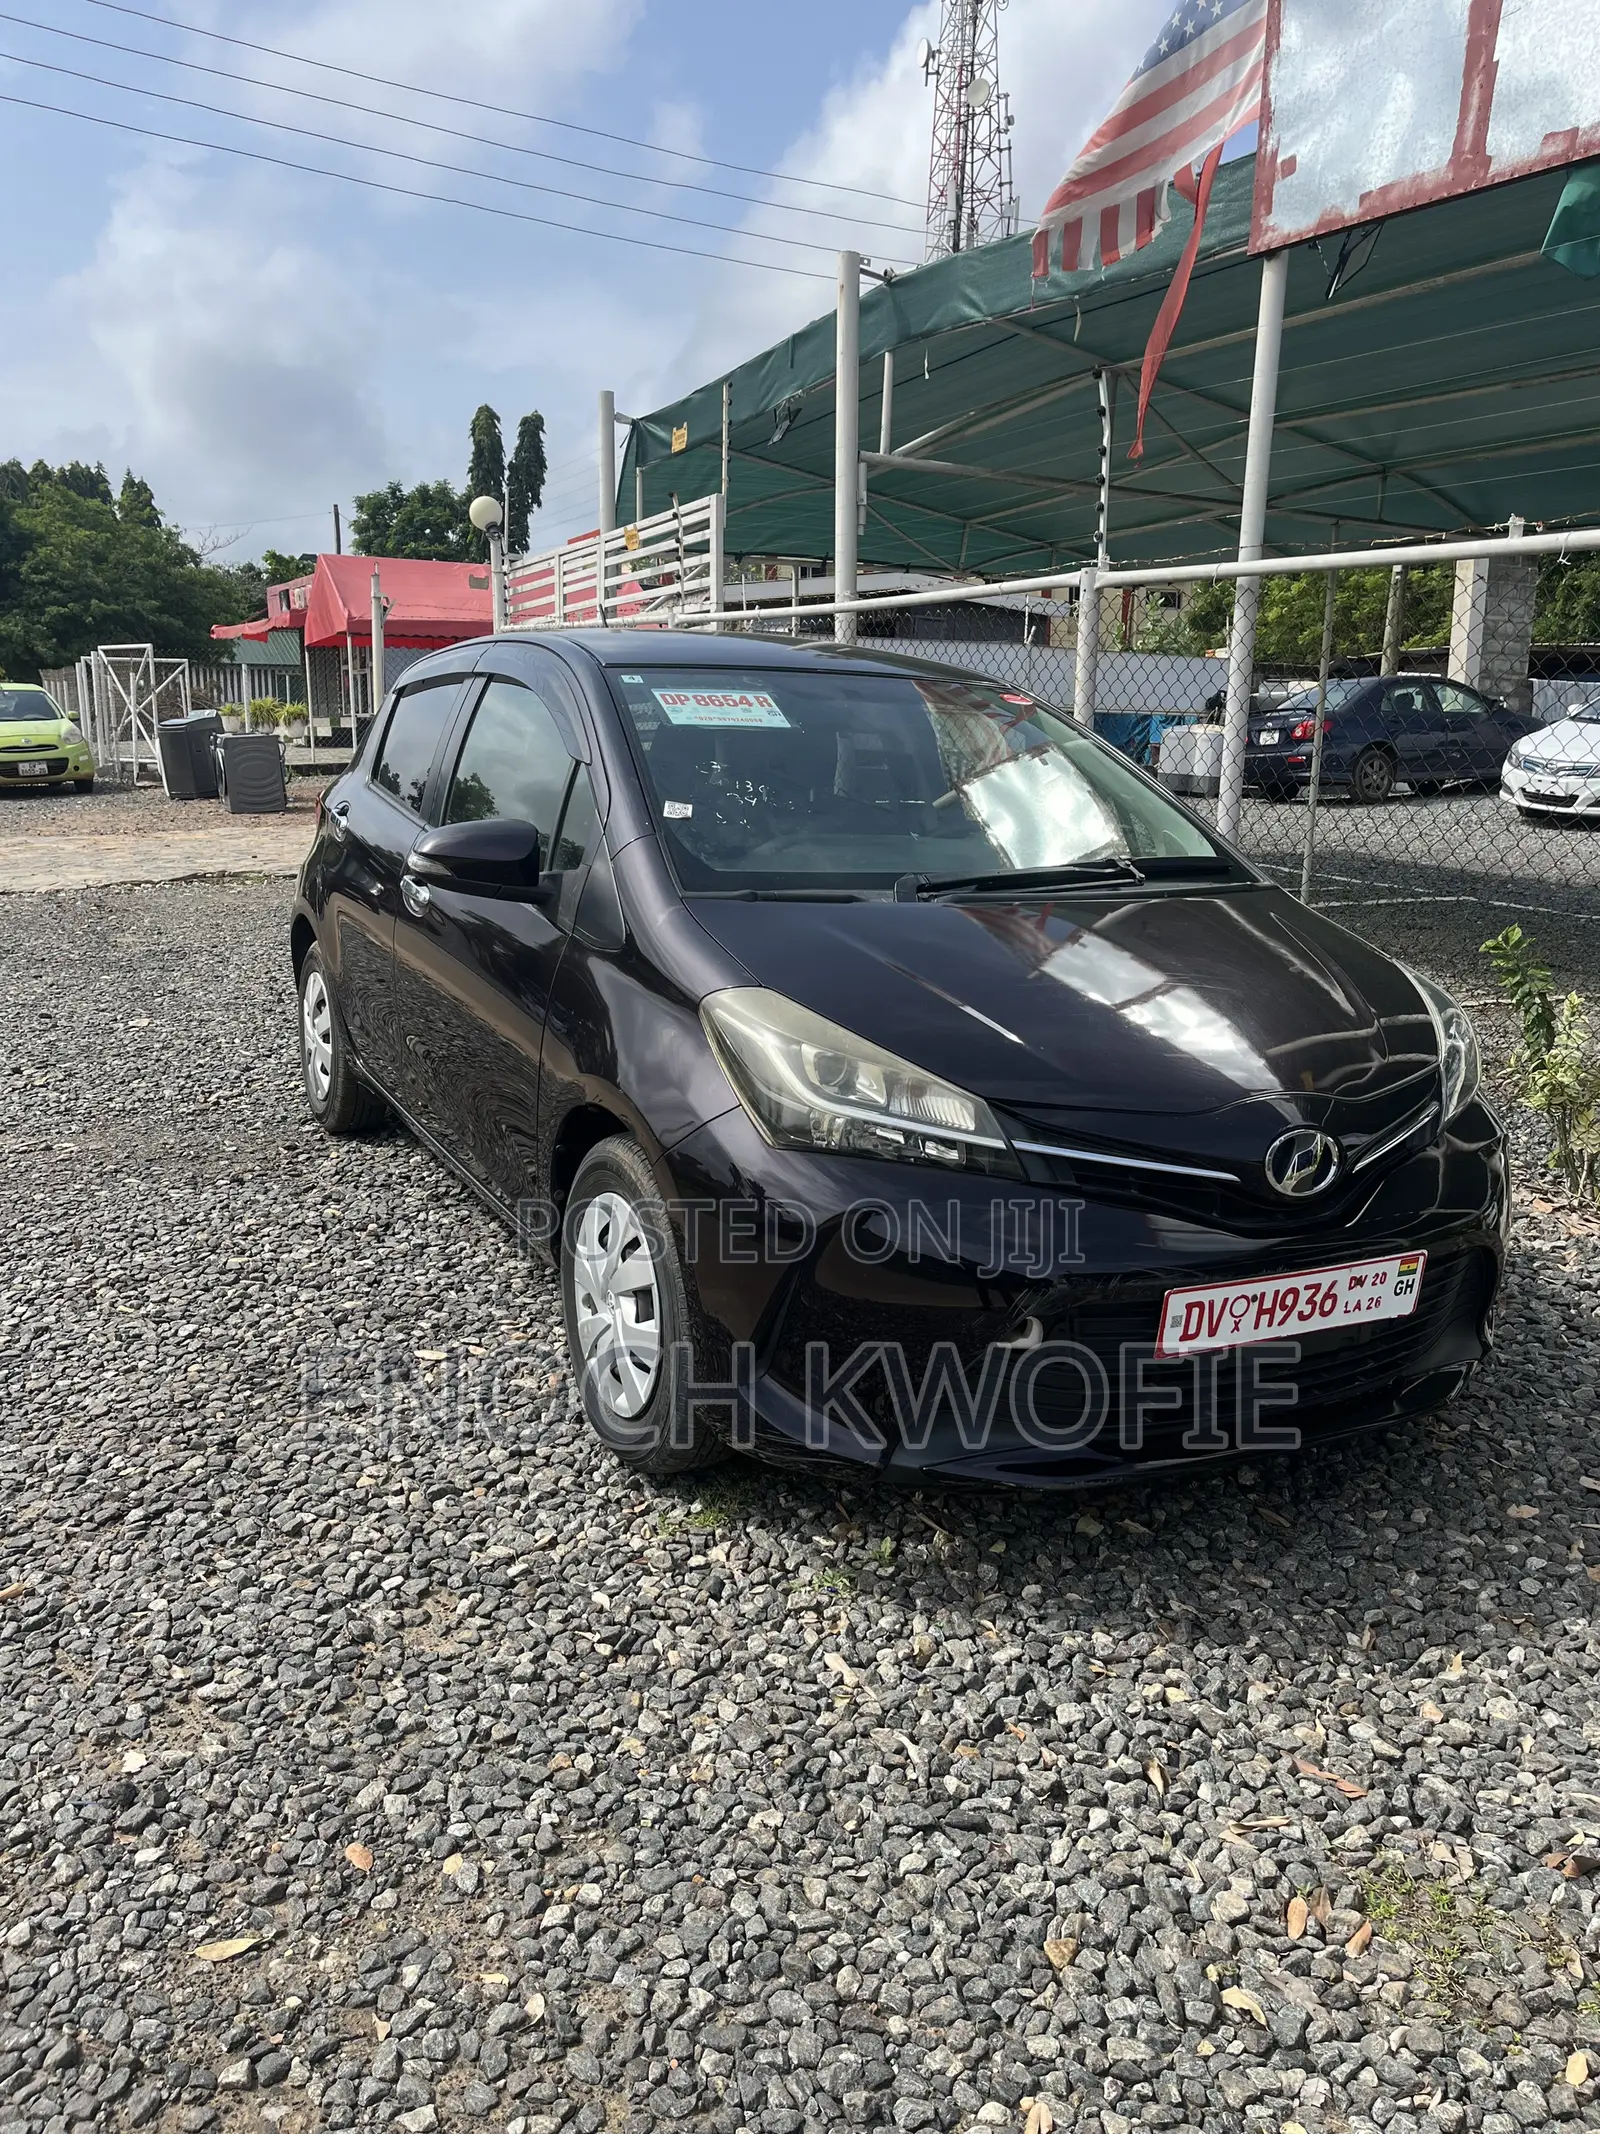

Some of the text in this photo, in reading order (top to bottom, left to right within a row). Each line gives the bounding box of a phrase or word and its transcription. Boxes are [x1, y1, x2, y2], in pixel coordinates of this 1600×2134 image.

[659, 693, 773, 708] DP 8654 R
[1371, 1271, 1388, 1287] 20
[1393, 1277, 1416, 1297] GH
[1253, 1279, 1338, 1330] H936
[1365, 1295, 1382, 1311] 26
